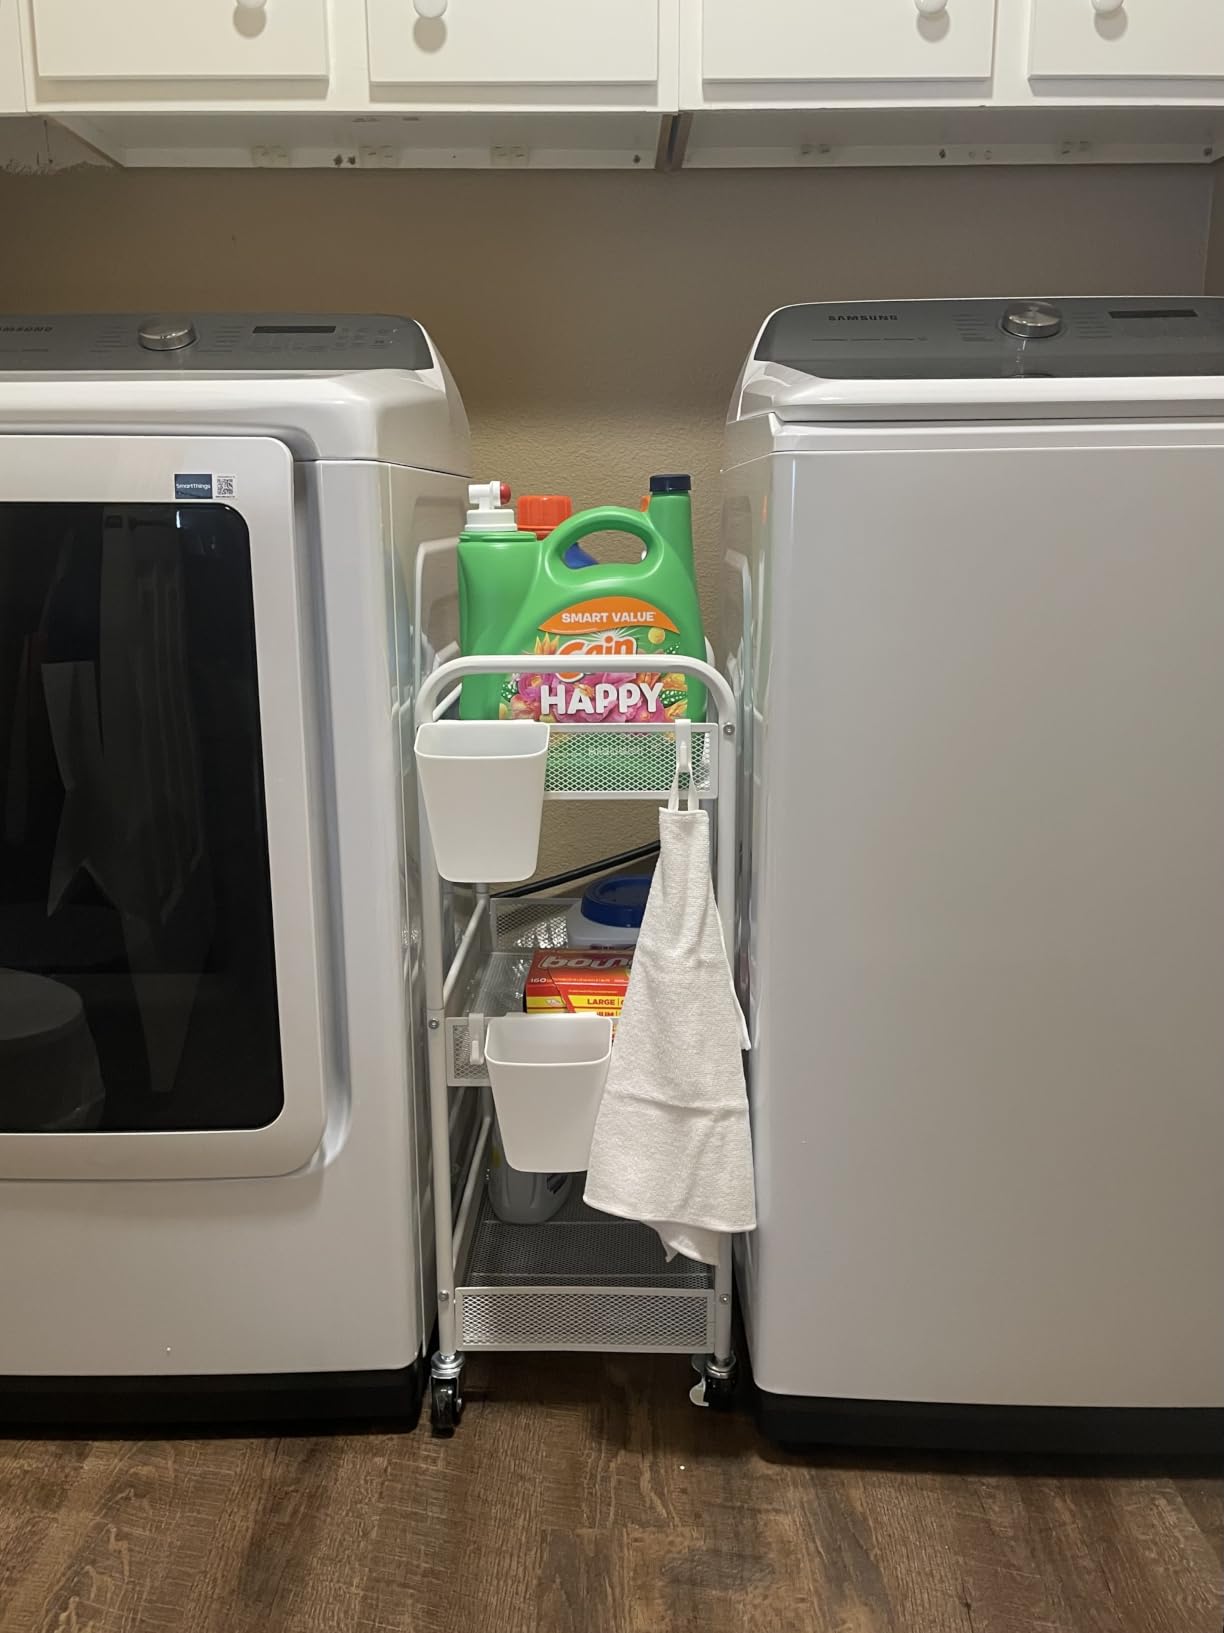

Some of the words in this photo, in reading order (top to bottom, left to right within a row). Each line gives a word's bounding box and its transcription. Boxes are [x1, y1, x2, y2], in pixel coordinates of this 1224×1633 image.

[561, 612, 608, 623] SMART
[612, 611, 655, 622] VALUE
[540, 682, 664, 715] HAPPY
[541, 954, 632, 968] boun
